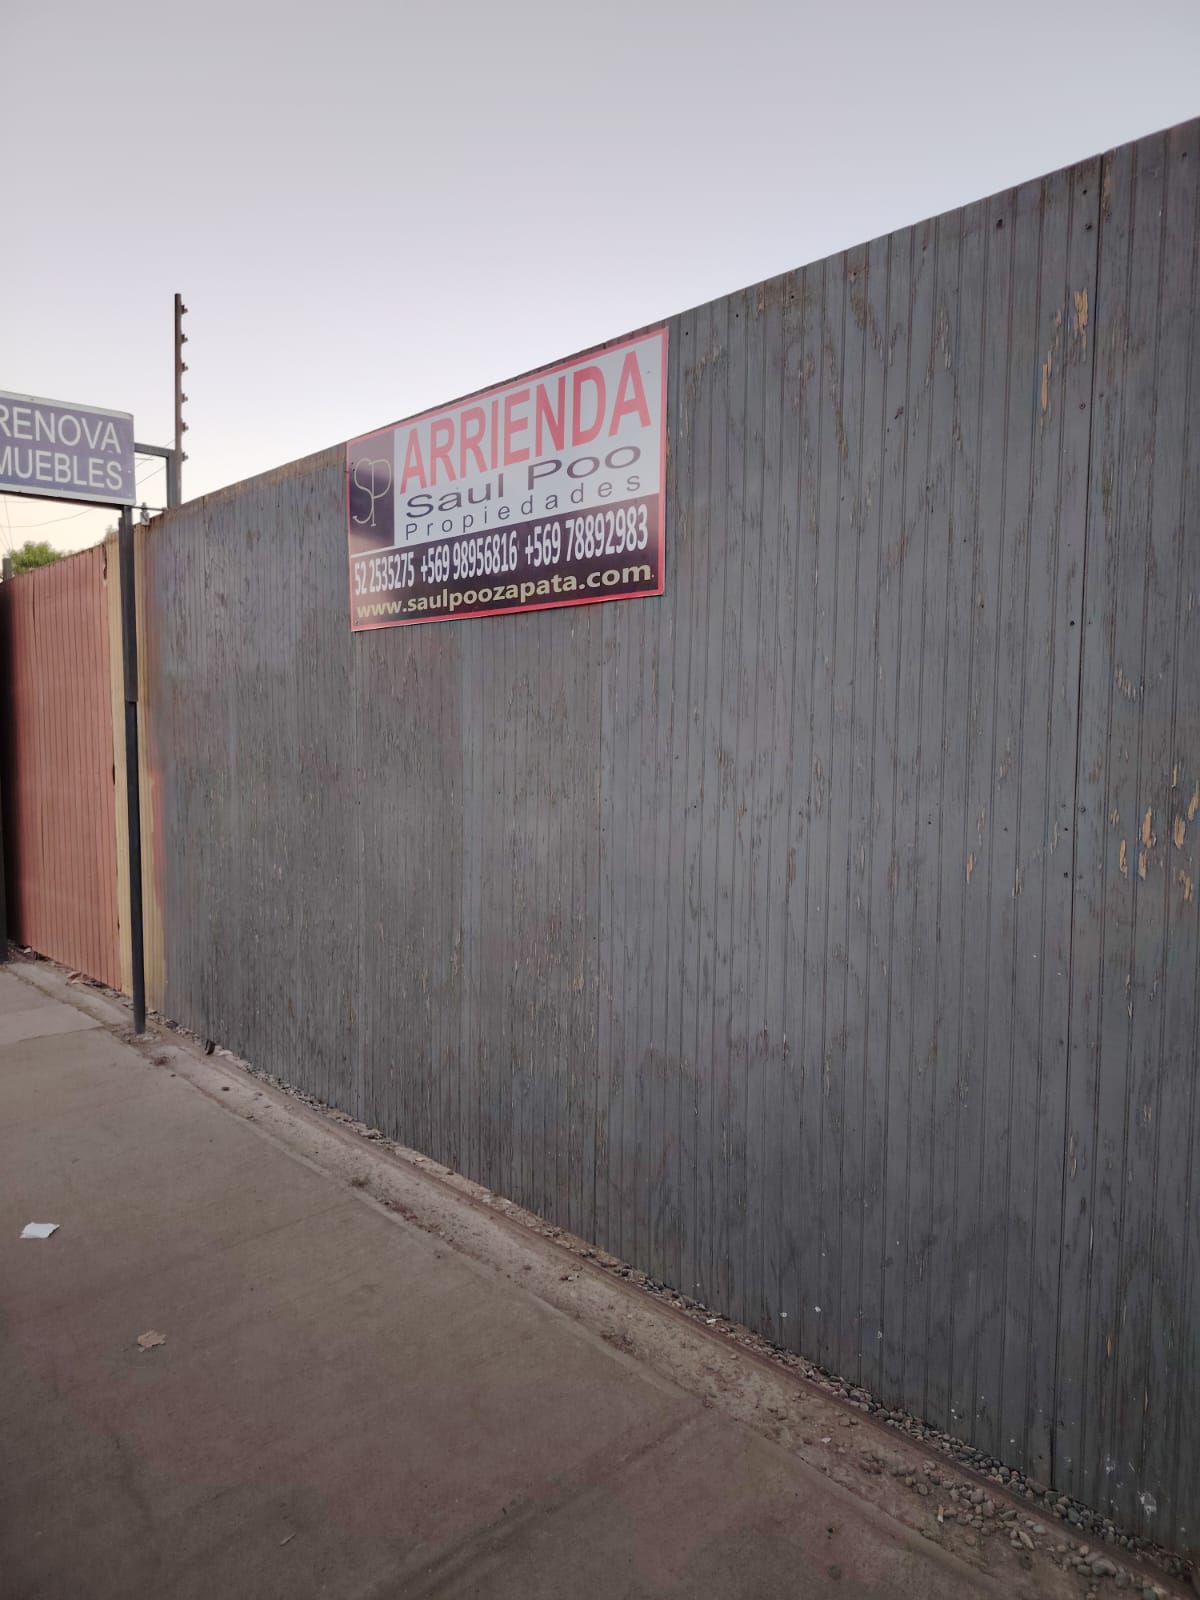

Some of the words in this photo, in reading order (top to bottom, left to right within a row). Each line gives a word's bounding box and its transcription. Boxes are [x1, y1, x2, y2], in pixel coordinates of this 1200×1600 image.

[400, 351, 650, 495] ARRIENDA
[405, 475, 641, 540] Propiedades
[406, 473, 504, 518] Saul
[528, 446, 641, 491] Poo
[355, 561, 367, 596] 52
[369, 551, 415, 593] 2535275
[421, 544, 450, 584] +569
[453, 531, 518, 580] 98956816
[525, 522, 561, 568] +569
[565, 503, 649, 562] 78892983
[356, 564, 651, 618] www.saulpoozapata.com
